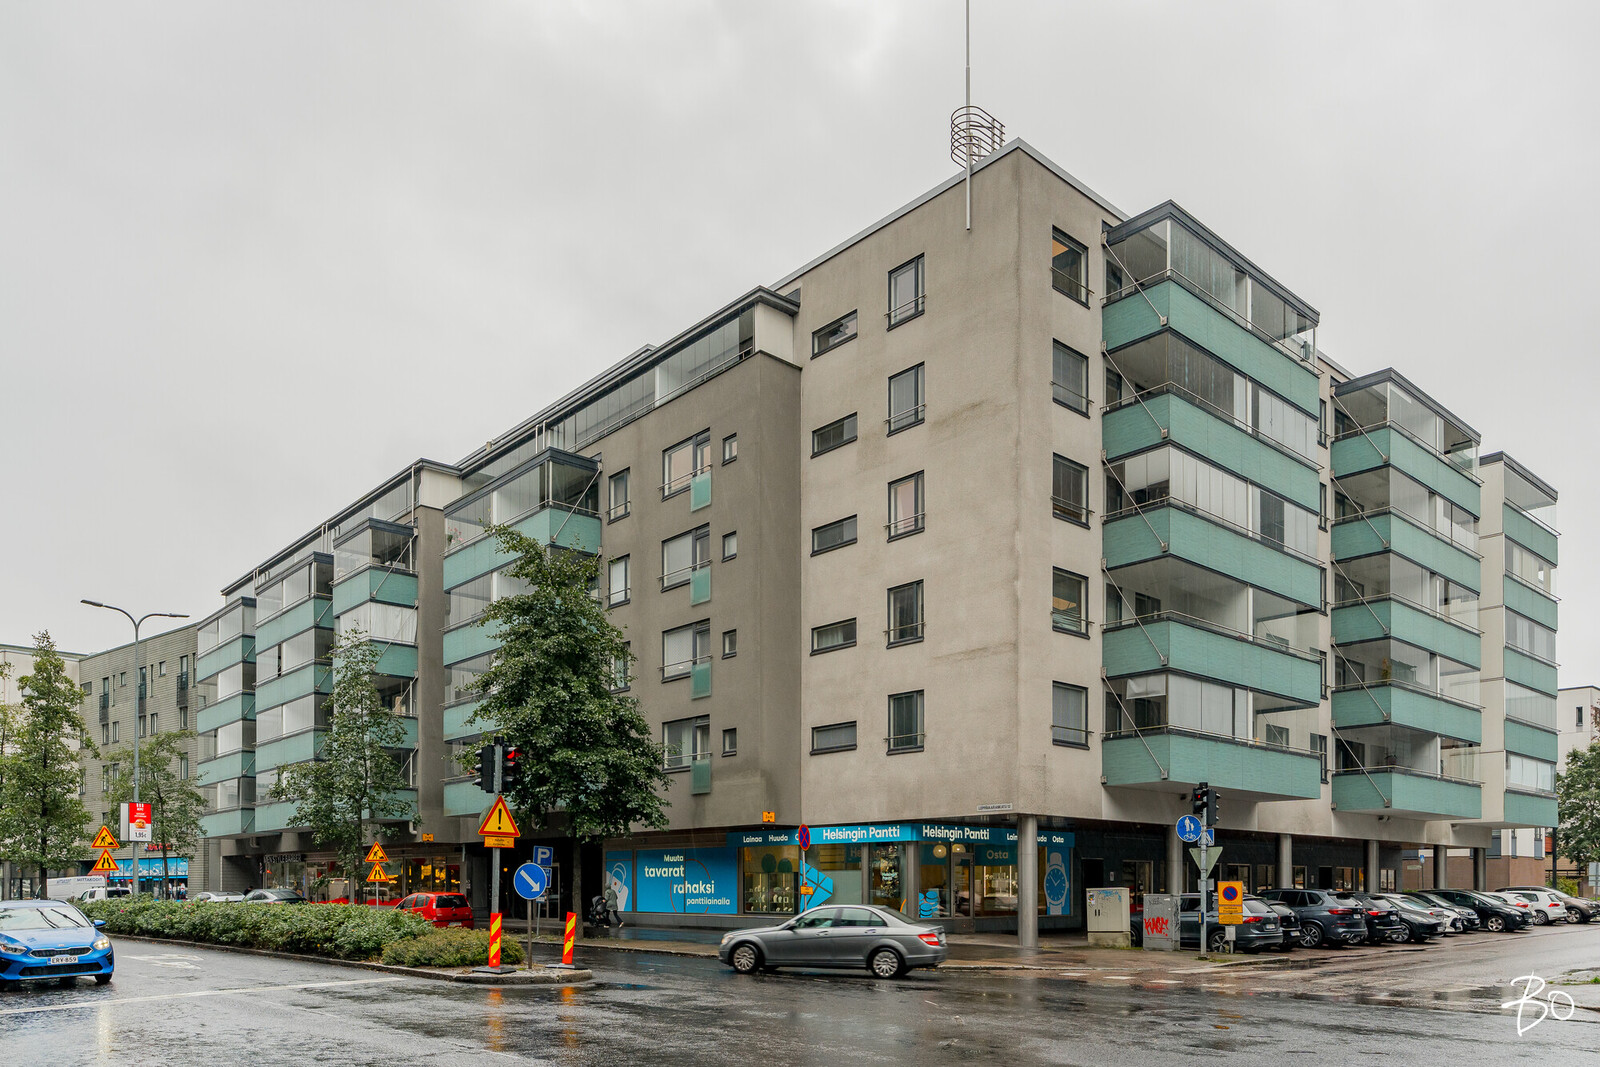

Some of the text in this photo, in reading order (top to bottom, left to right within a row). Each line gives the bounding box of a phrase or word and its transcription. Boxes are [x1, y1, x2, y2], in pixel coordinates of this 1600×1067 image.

[743, 835, 763, 843] Lainaa
[768, 834, 788, 842] Huuda
[822, 825, 900, 843] Helsingin Pantti
[922, 825, 990, 841] Helsingin Pantti
[1006, 832, 1065, 843] Lain uda Osta
[663, 854, 684, 862] Muuta
[986, 849, 1009, 860] Osta
[644, 865, 685, 878] tavarat
[673, 880, 715, 894] rahaksi
[686, 897, 731, 906] panttilainalla
